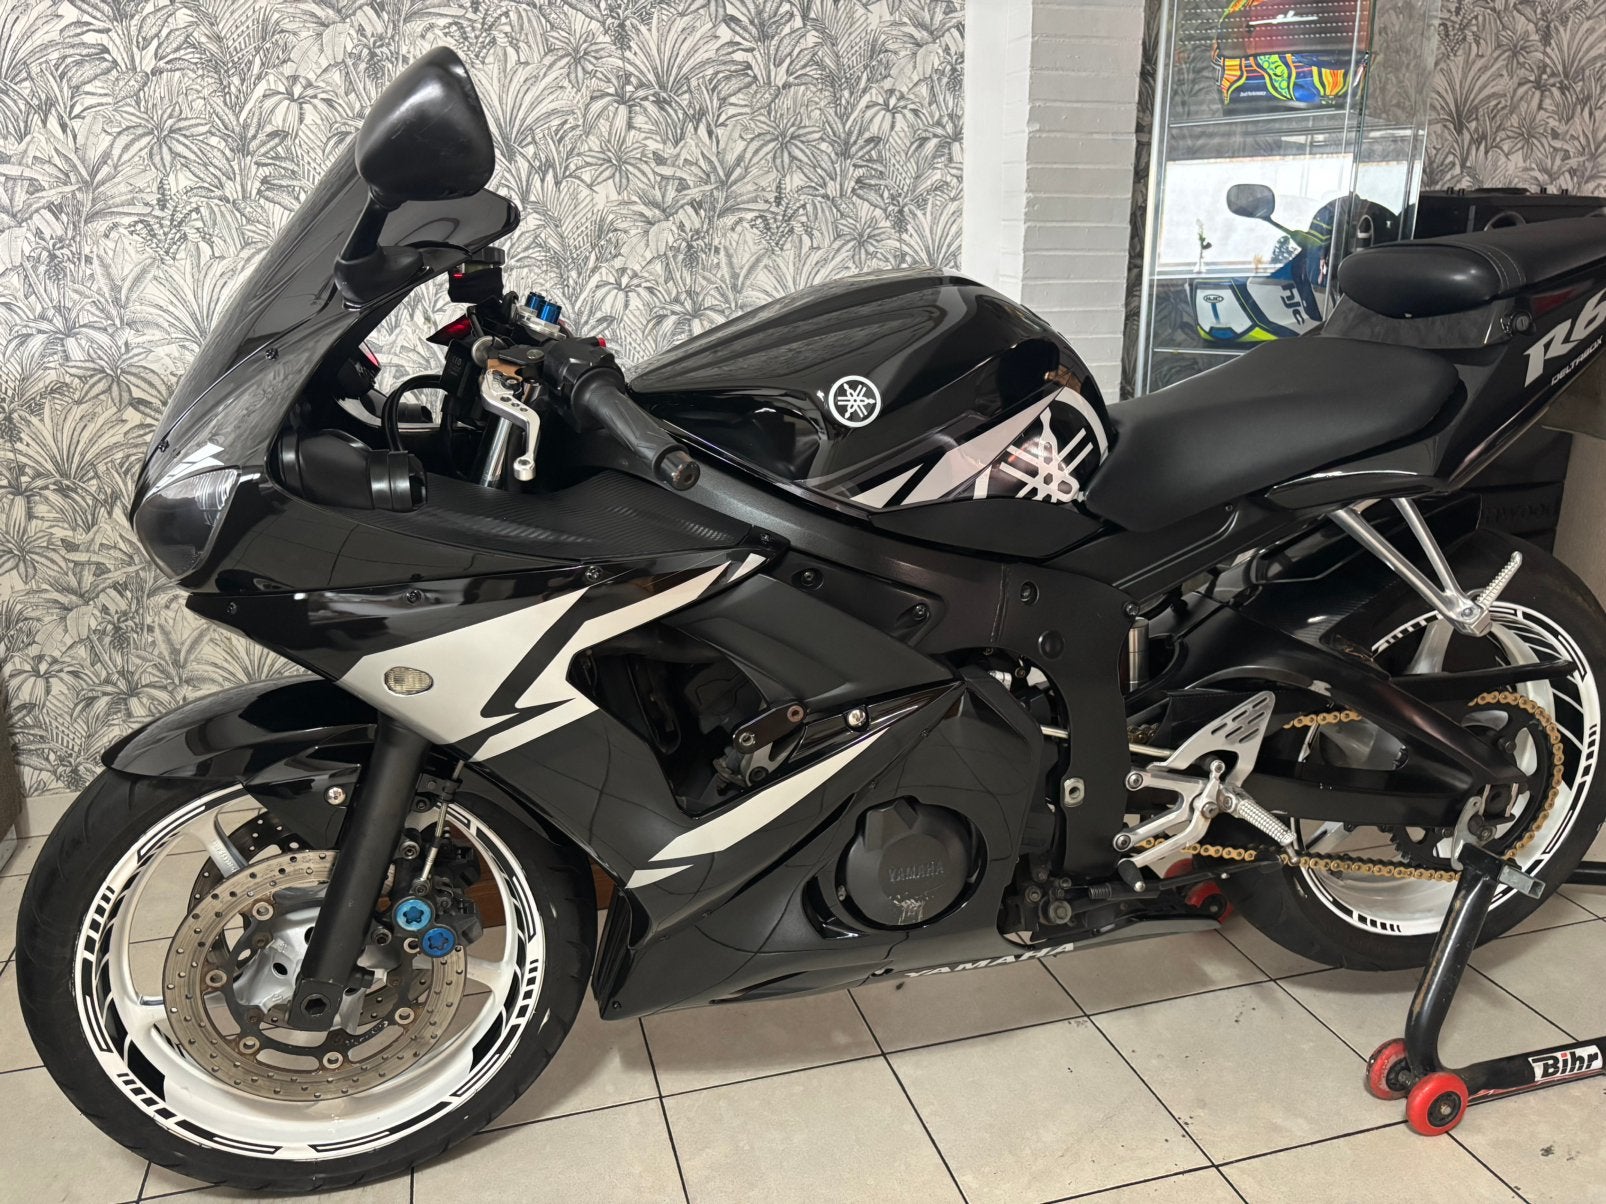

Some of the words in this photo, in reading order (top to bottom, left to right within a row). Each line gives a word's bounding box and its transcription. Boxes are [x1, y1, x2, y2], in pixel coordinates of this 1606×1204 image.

[1523, 287, 1606, 388] R6
[888, 861, 945, 883] YAMAHA
[904, 942, 1074, 978] YAMAHA
[1531, 1051, 1599, 1079] Bihr
